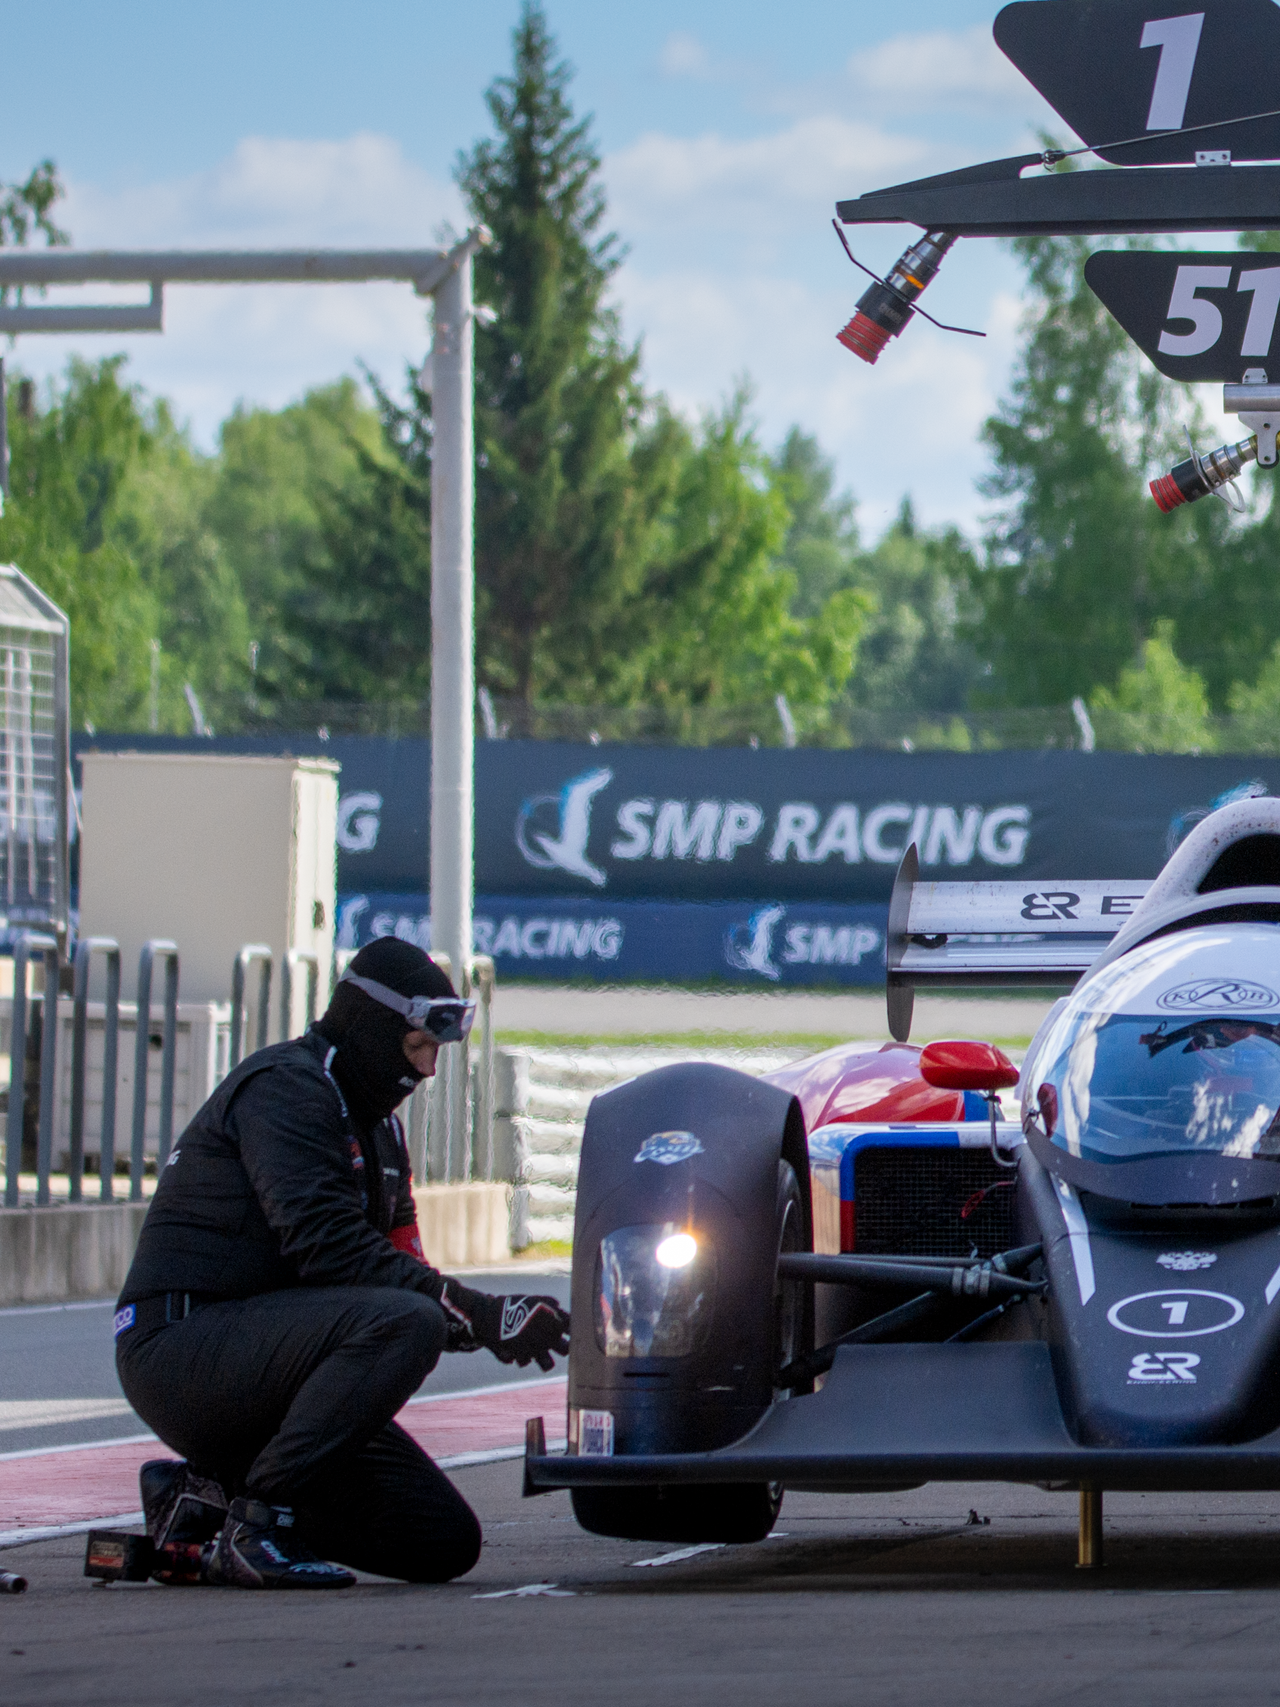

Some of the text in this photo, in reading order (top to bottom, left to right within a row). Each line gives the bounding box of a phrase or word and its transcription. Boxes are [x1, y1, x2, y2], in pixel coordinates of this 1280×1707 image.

[1139, 12, 1205, 130] 1
[610, 799, 1032, 866] SMP RACING
[473, 915, 625, 959] RACING
[784, 923, 880, 965] SMP
[1161, 1301, 1189, 1325] 1
